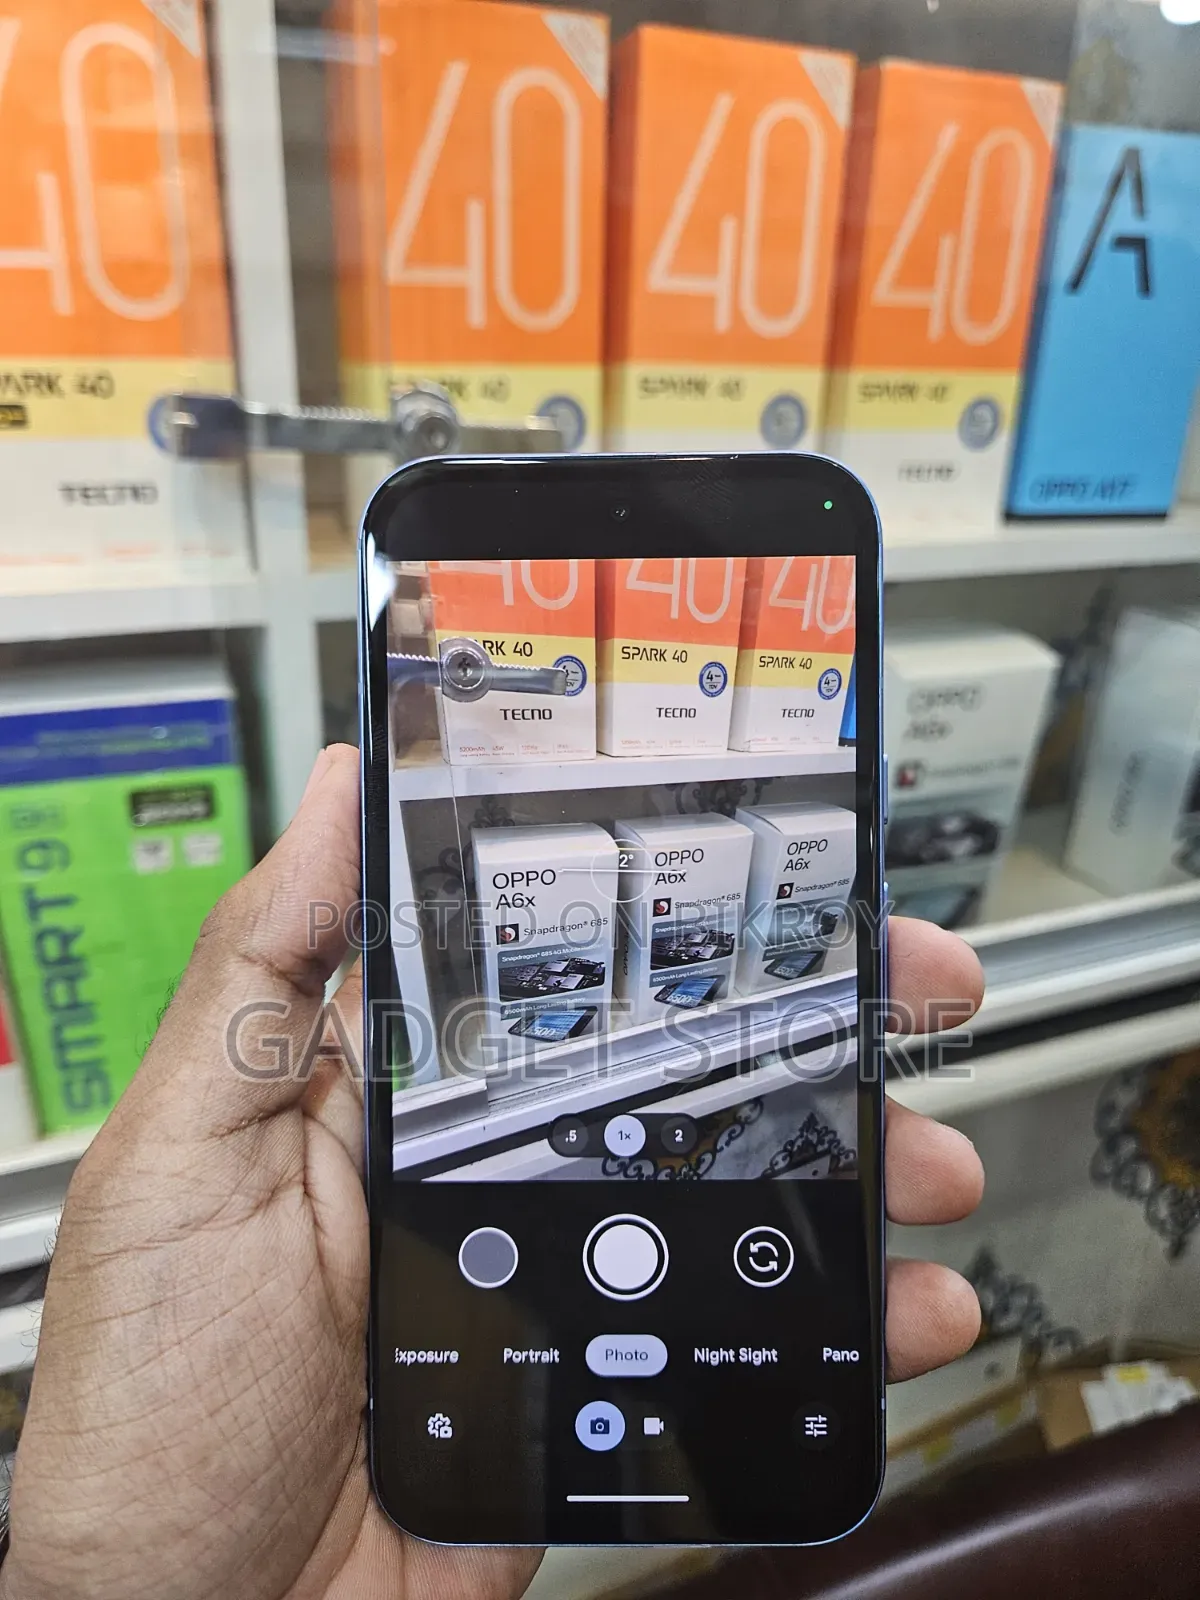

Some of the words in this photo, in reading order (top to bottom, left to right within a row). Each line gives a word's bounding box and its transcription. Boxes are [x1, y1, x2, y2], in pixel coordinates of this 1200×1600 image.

[385, 59, 581, 333] 40
[646, 91, 828, 339] 40
[1066, 144, 1154, 298] A
[870, 120, 1035, 346] 40
[514, 641, 533, 657] 40
[621, 646, 668, 661] SPARK
[672, 649, 688, 664] 40
[759, 655, 797, 669] SPARK
[799, 657, 813, 670] 40
[499, 708, 553, 721] TECNO
[656, 707, 697, 719] TECNO
[781, 708, 815, 719] TECNO
[787, 839, 828, 855] OPPO
[655, 848, 704, 867] OPPO
[783, 857, 811, 872] A6x
[493, 868, 556, 889] OPPO
[655, 869, 687, 885] A6x
[496, 892, 536, 910] A6x
[727, 893, 741, 902] 685
[590, 917, 609, 928] 685
[23, 887, 112, 1113] SMART
[565, 1129, 578, 1143] .5
[674, 1129, 683, 1142] 2
[503, 1347, 560, 1363] Portrait
[604, 1347, 649, 1362] Photo
[694, 1347, 735, 1367] Night
[739, 1347, 778, 1367] Sight
[823, 1347, 860, 1363] Pano
